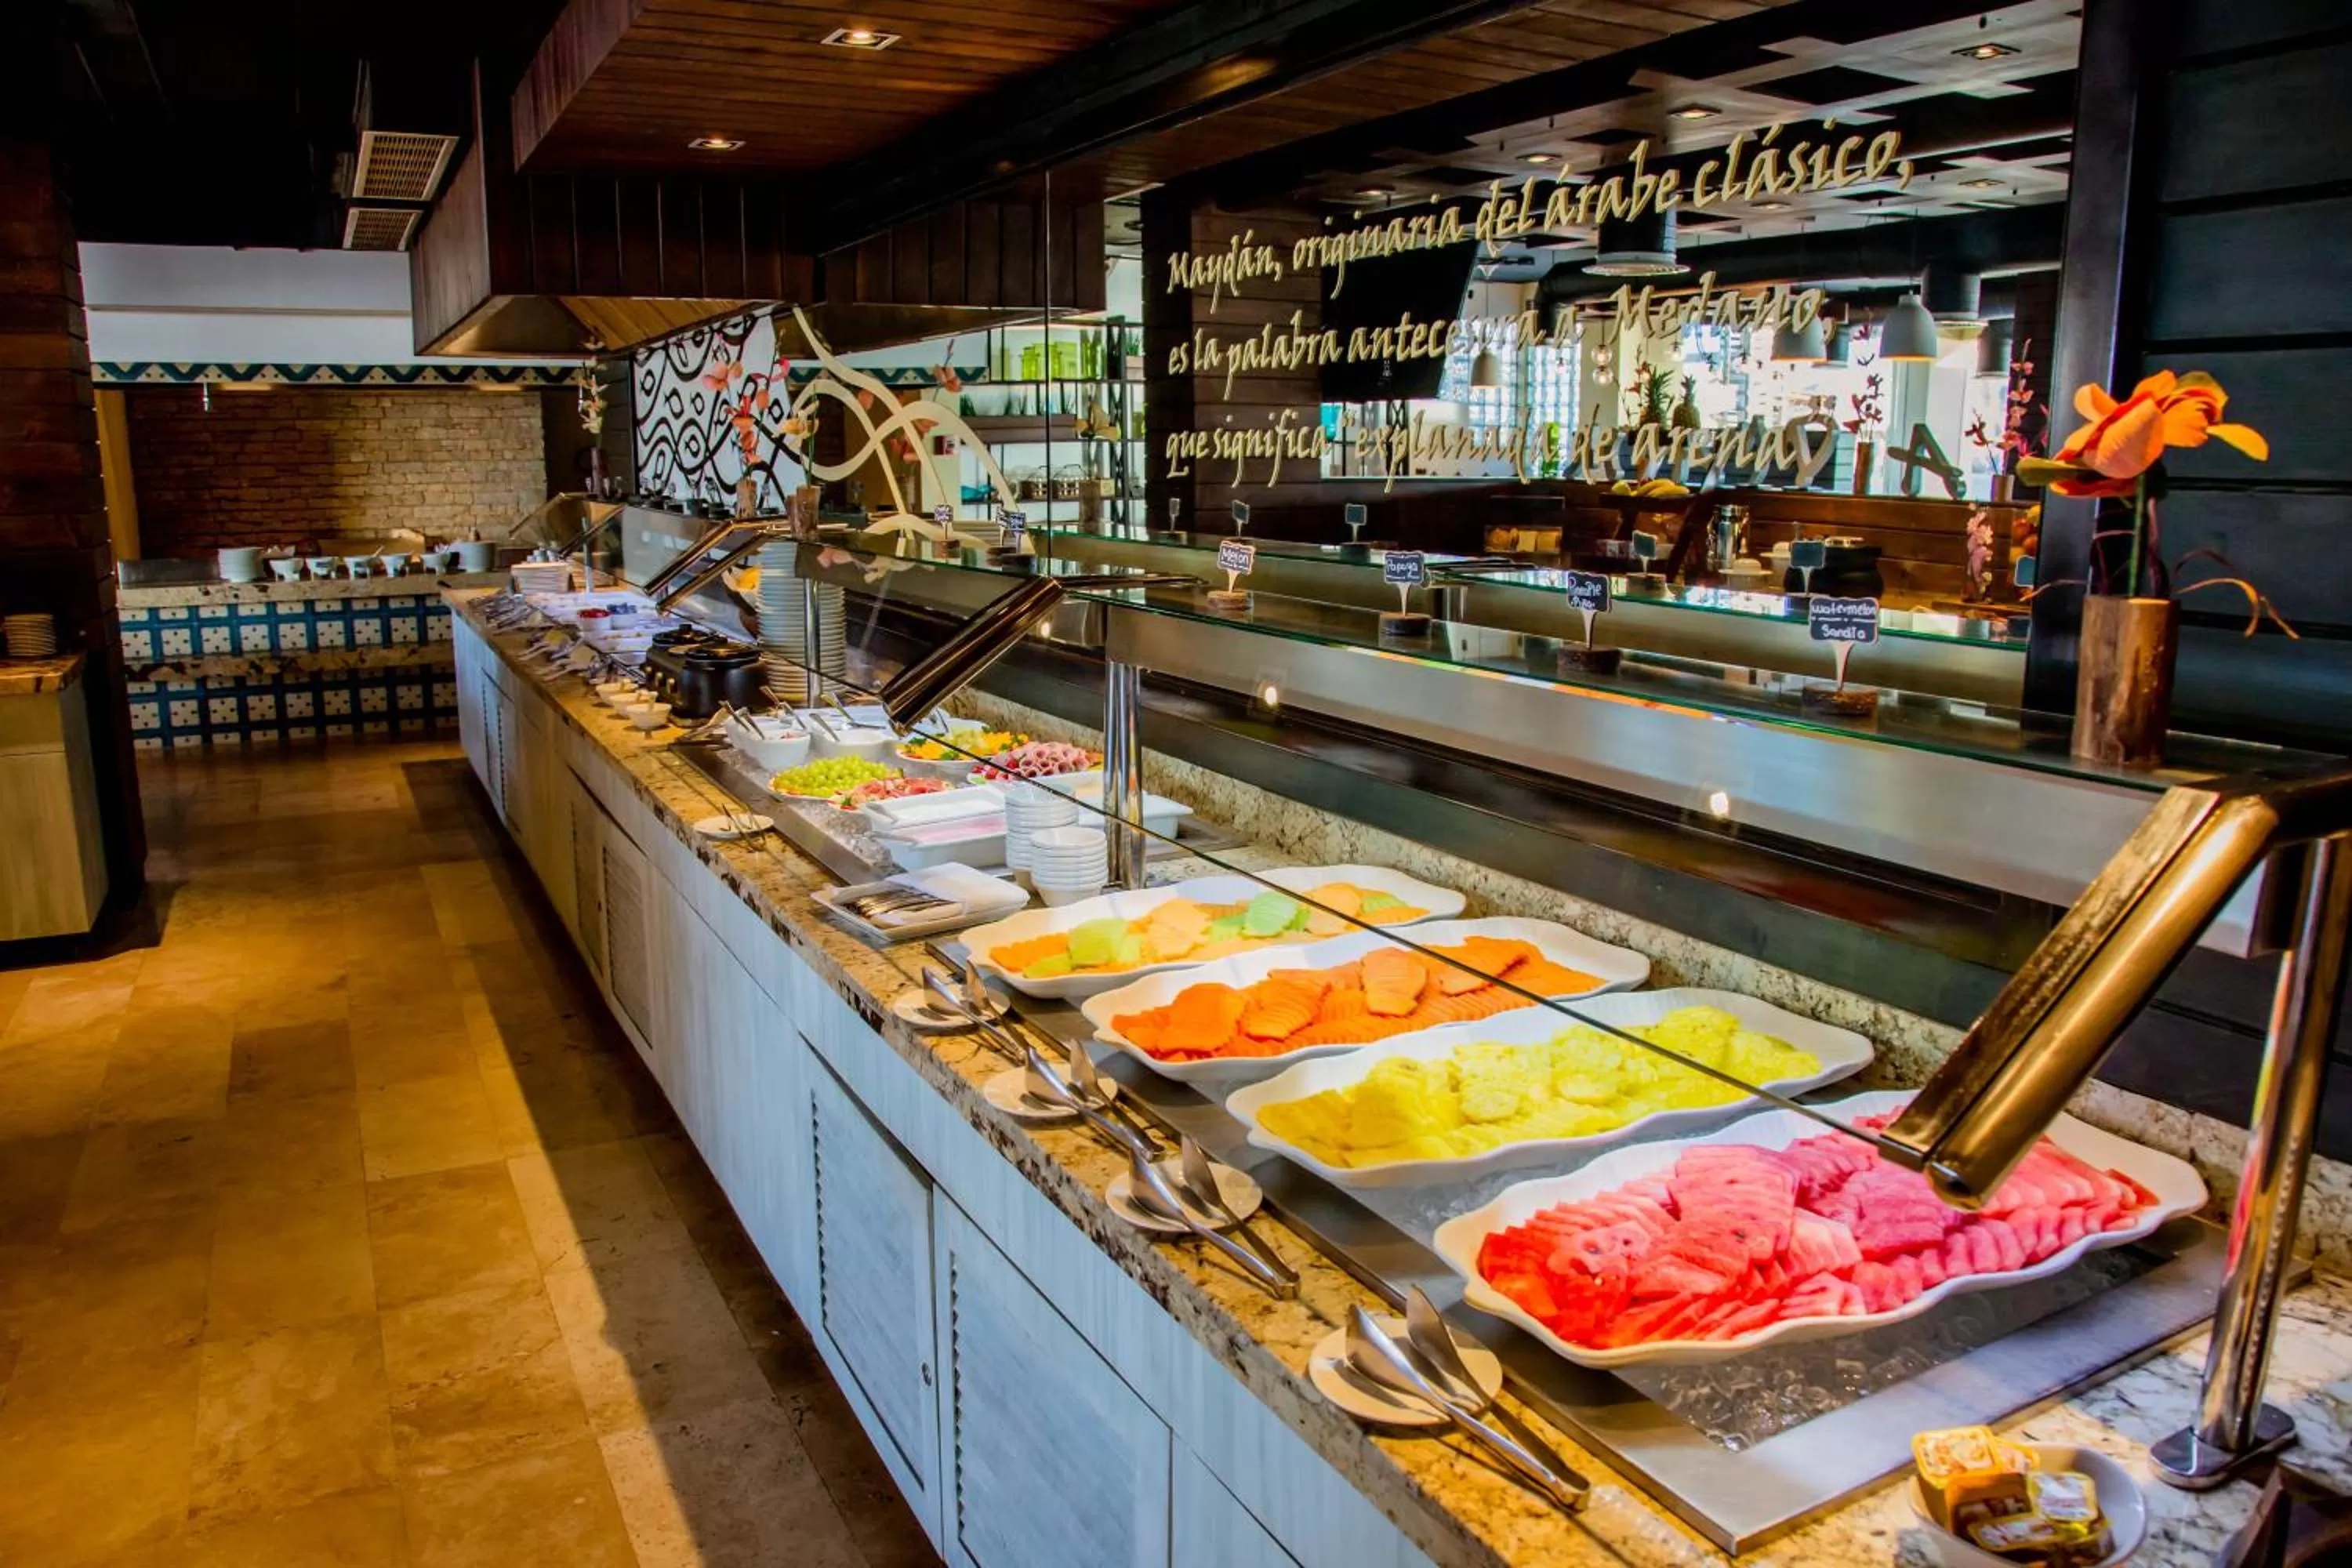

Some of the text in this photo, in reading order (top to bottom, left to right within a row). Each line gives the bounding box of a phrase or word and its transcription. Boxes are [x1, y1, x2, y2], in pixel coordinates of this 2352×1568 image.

[1167, 118, 1915, 314] Maydán, originaria del árabe clásico,
[1168, 342, 1189, 375] es
[1194, 328, 1223, 371] la
[1223, 309, 1343, 401] palabra
[1553, 304, 1585, 350] a
[1166, 426, 1210, 478] que
[1213, 410, 1331, 488] significa
[1570, 403, 1618, 485] de
